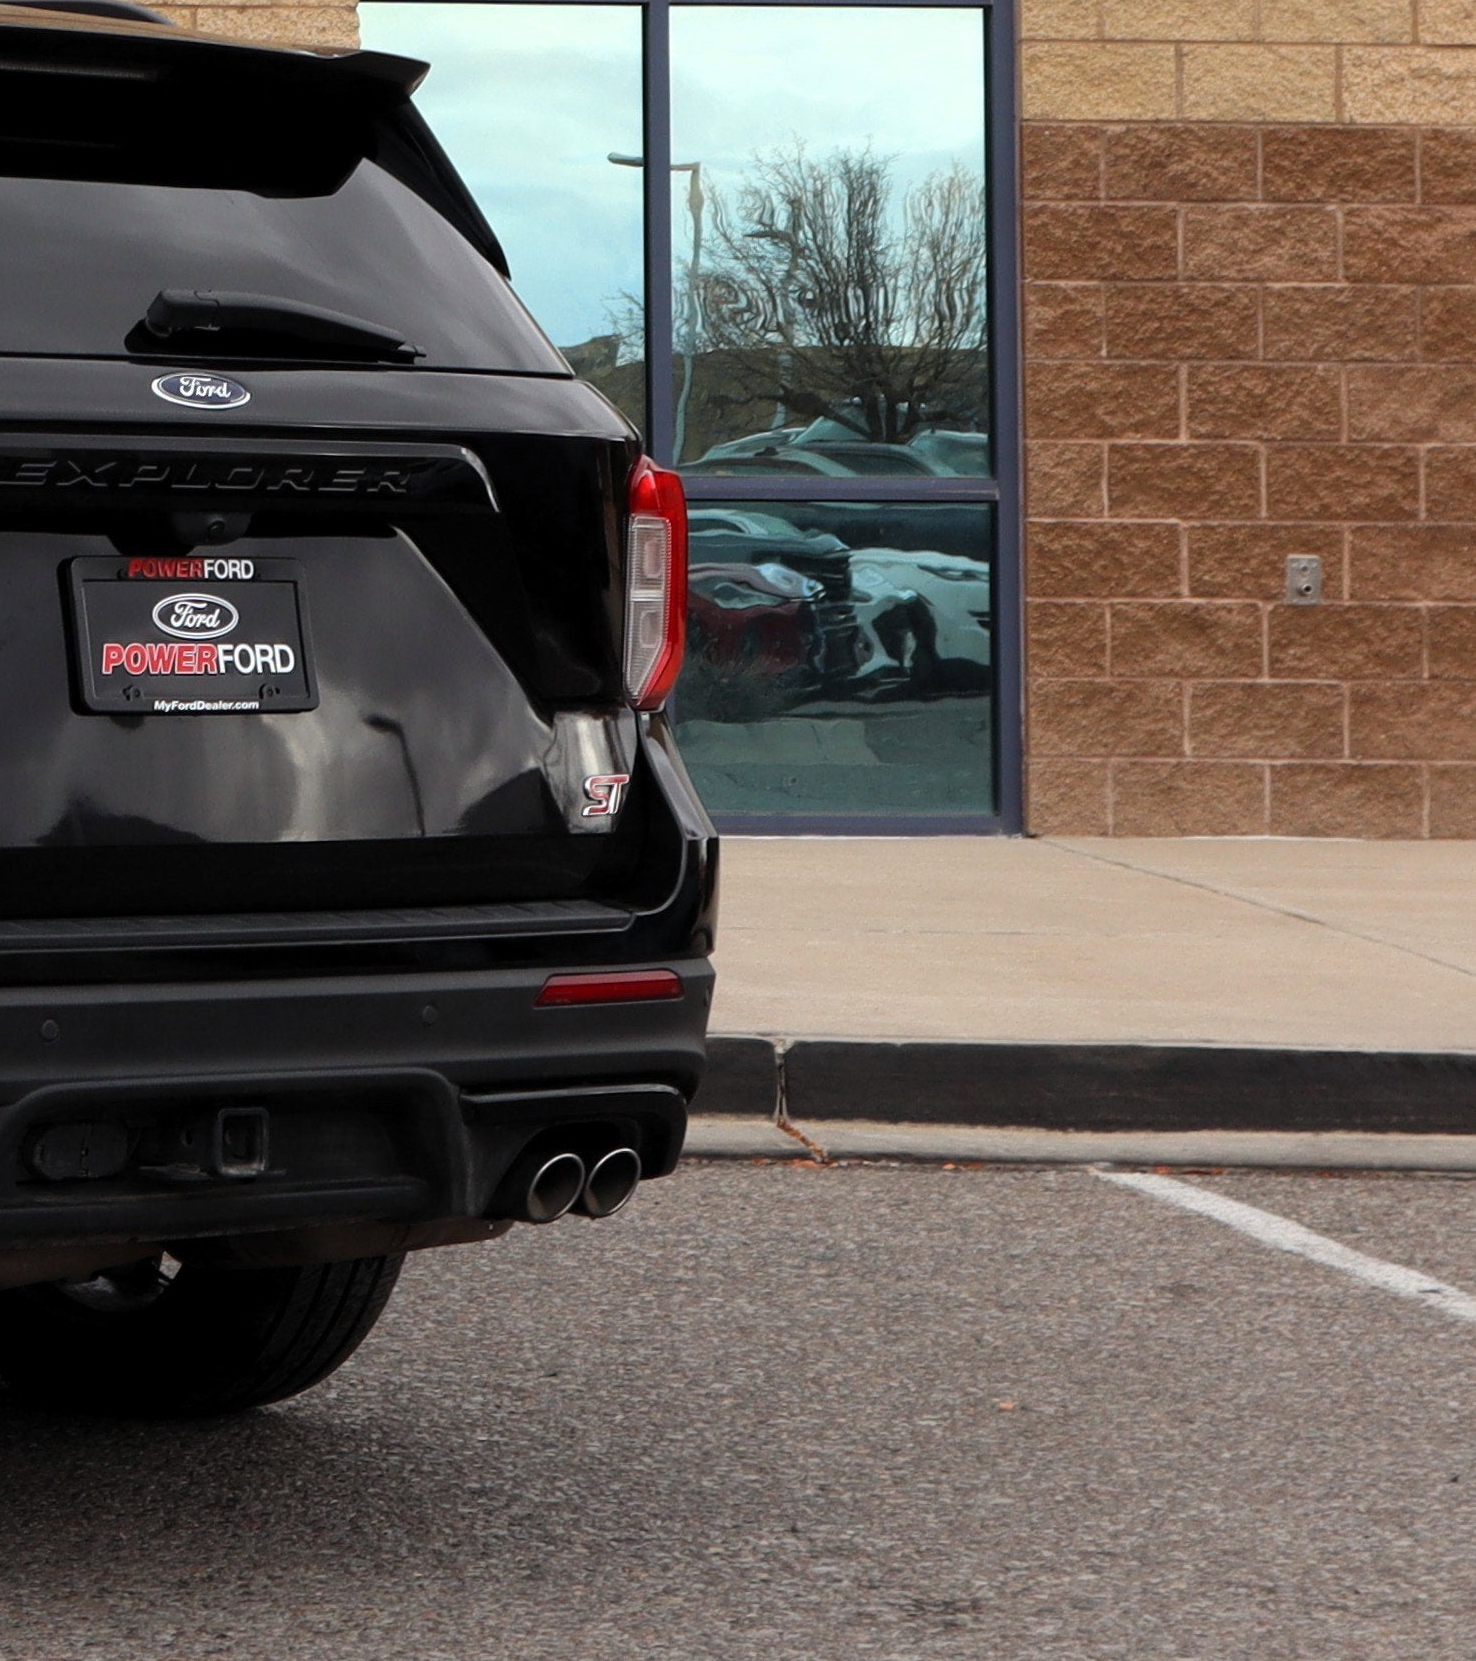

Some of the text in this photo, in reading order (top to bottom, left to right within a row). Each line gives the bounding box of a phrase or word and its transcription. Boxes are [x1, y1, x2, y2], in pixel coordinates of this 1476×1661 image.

[179, 376, 231, 398] Ford
[128, 557, 255, 580] POWERFORD
[170, 601, 221, 629] Ford
[102, 642, 296, 675] POWERFORD
[153, 699, 260, 713] MyFordDealer.com
[582, 774, 630, 816] ST
